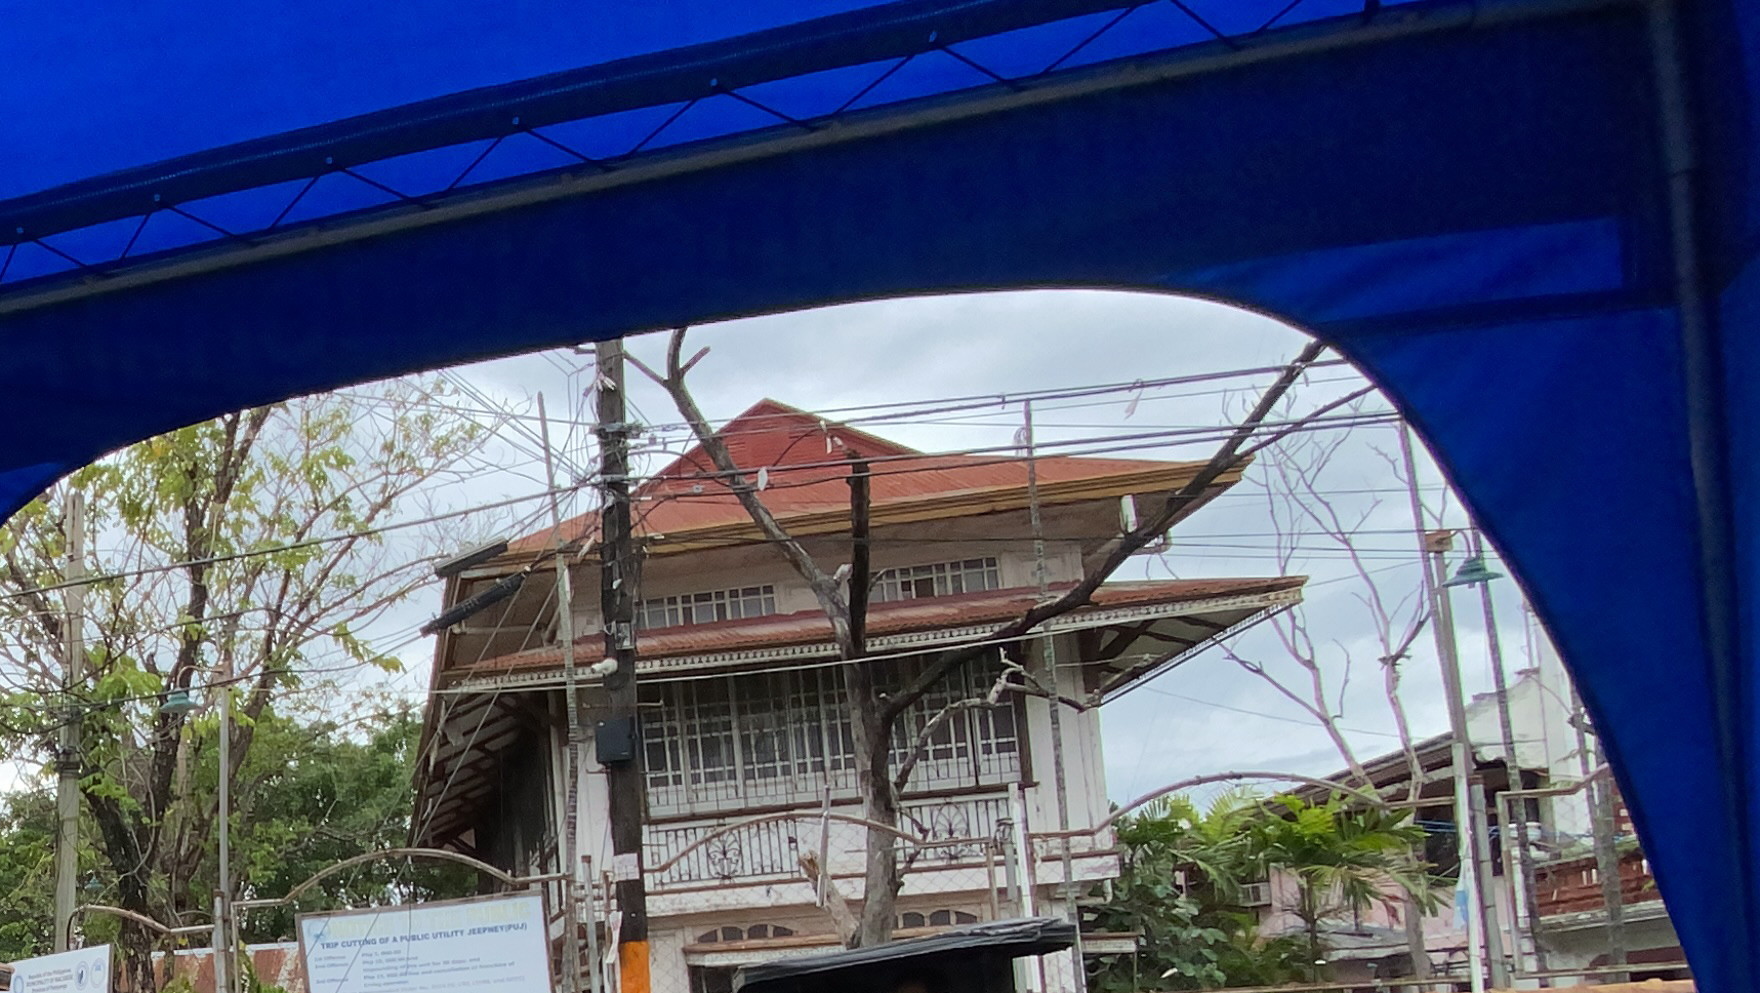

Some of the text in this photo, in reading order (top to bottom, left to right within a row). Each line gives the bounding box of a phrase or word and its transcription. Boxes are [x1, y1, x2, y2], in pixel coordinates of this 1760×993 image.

[321, 941, 339, 949] TRIP
[341, 938, 377, 948] CUTTING
[400, 933, 430, 942] PUBLIC
[432, 929, 464, 939] UTILITY
